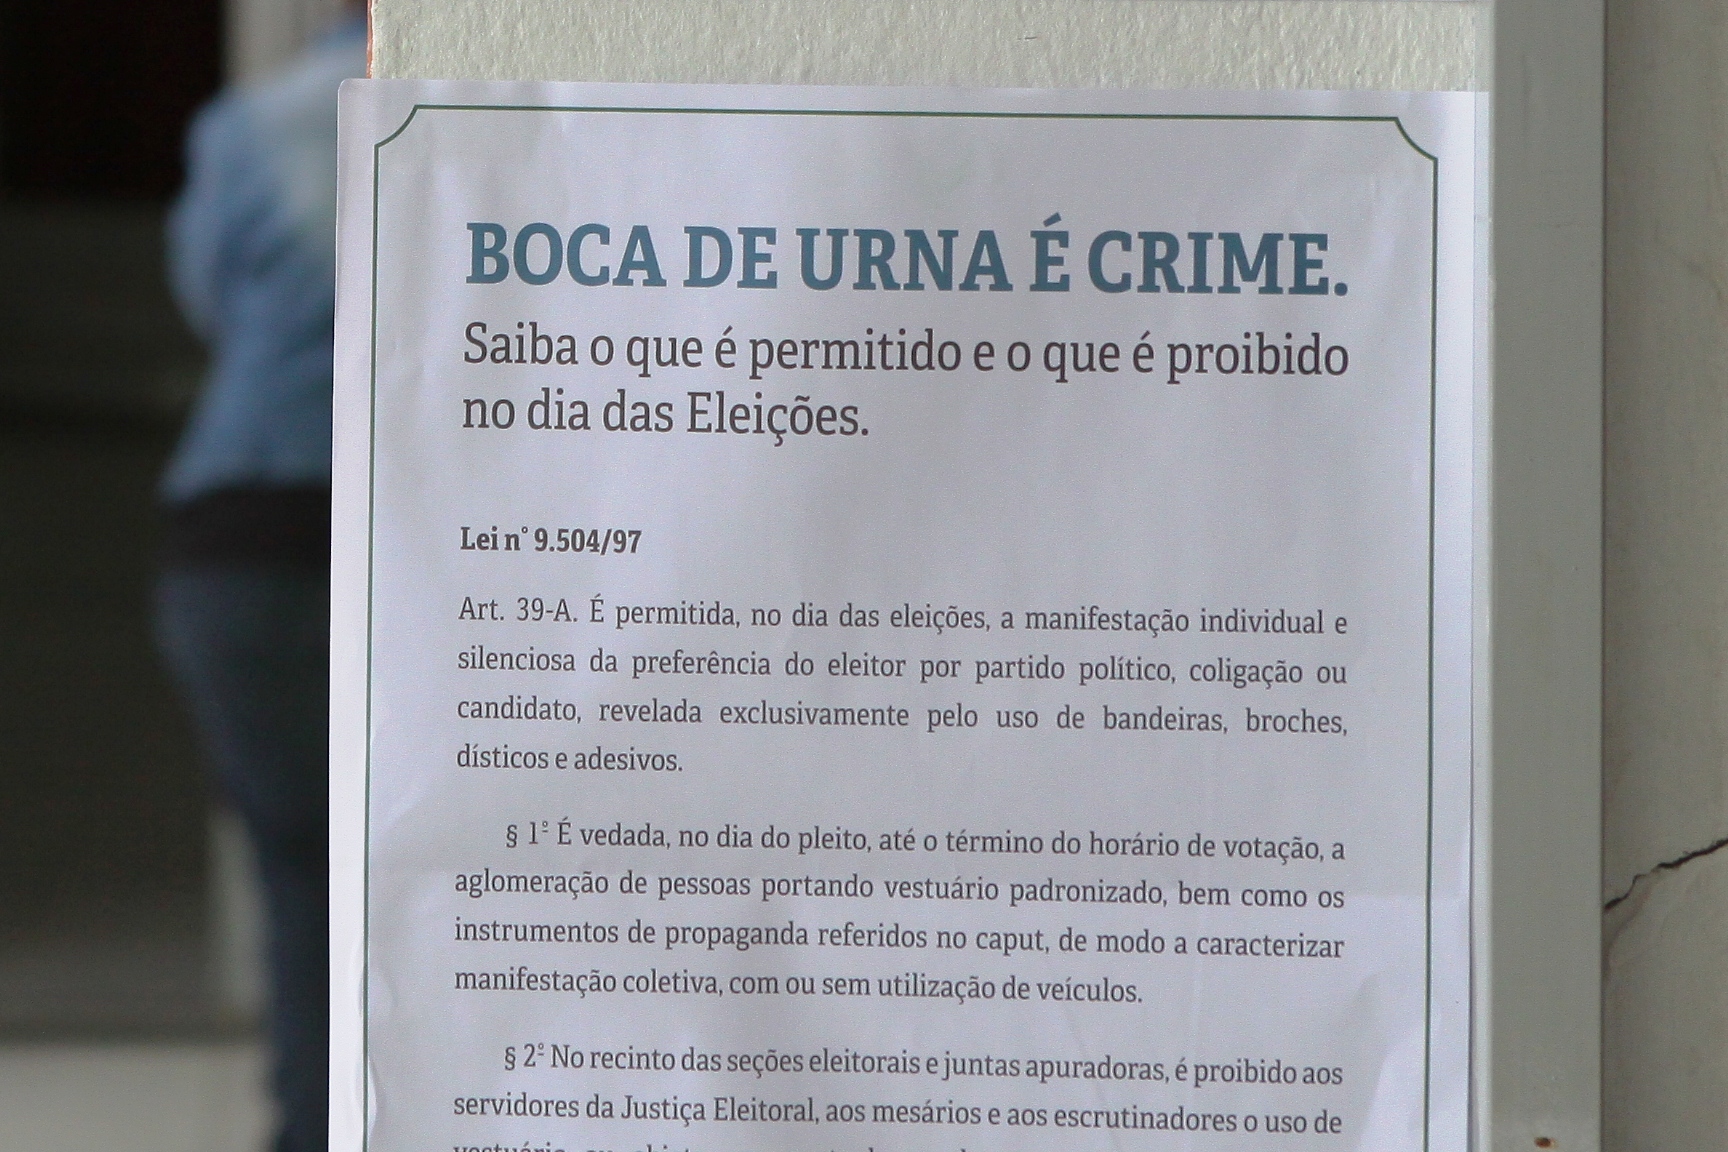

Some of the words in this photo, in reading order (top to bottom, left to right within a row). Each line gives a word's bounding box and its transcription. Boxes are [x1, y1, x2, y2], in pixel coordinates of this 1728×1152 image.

[465, 221, 668, 288] BOCA
[682, 225, 778, 290] DE
[795, 227, 1014, 292] URNA
[1029, 212, 1071, 293] É
[1087, 229, 1349, 297] CRIME.
[463, 321, 579, 366] Saiba
[590, 335, 615, 367] o
[626, 335, 703, 378] que
[714, 324, 737, 369] é
[748, 327, 962, 381] permitido
[973, 340, 995, 372] e
[1007, 341, 1032, 372] o
[1043, 341, 1121, 384] que
[1132, 329, 1155, 374] é
[1166, 331, 1349, 385] proibido
[462, 398, 516, 430] no
[527, 386, 592, 431] dia
[602, 388, 674, 433] das
[686, 390, 869, 448] Eleições.
[459, 525, 500, 551] Lei
[533, 527, 643, 556] 9.504/97
[457, 596, 505, 621] Art.
[516, 596, 578, 623] 39-A.
[589, 592, 605, 623] É
[615, 599, 741, 630] permitida,
[750, 608, 782, 627] no
[791, 601, 829, 627] dia
[839, 602, 880, 628] das
[890, 602, 991, 636] eleições,
[1000, 611, 1015, 630] a
[1024, 605, 1190, 639] manifestação
[1199, 607, 1325, 635] individual
[1334, 616, 1348, 635] e
[457, 644, 576, 672] silenciosa
[589, 647, 619, 673] da
[631, 648, 772, 680] preferência
[784, 650, 815, 677] do
[827, 651, 907, 677] eleitor
[919, 659, 962, 684] por
[975, 654, 1065, 685] partido
[1078, 655, 1176, 687] político,
[1189, 656, 1303, 690] coligação
[1316, 665, 1348, 685] ou
[457, 694, 582, 725] candidato,
[598, 697, 703, 724] revelada
[719, 699, 910, 727] exclusivamente
[926, 702, 978, 734] pelo
[996, 710, 1039, 729] uso
[1056, 703, 1085, 730] de
[1102, 704, 1228, 735] bandeiras,
[1245, 706, 1348, 737] broches,
[456, 742, 549, 770] dísticos
[554, 751, 568, 770] e
[573, 745, 683, 772] adesivos.
[505, 823, 518, 849] §
[556, 815, 572, 846] É
[579, 821, 671, 851] vedada,
[678, 829, 709, 848] no
[716, 823, 754, 849] dia
[760, 824, 791, 849] do
[797, 825, 872, 856] pleito,
[879, 827, 916, 852] até
[923, 834, 938, 852] o
[945, 828, 1044, 854] término
[1051, 829, 1082, 855] do
[1088, 830, 1180, 857] horário
[1187, 832, 1216, 858] de
[1222, 836, 1325, 866] votação,
[1331, 842, 1346, 861] a
[454, 867, 609, 901] aglomeração
[619, 868, 648, 895] de
[657, 876, 751, 901] pessoas
[761, 872, 874, 903] portando
[883, 875, 999, 901] vestuário
[1009, 877, 1168, 908] padronizado,
[1177, 879, 1231, 906] bem
[1240, 888, 1308, 908] como
[1317, 889, 1345, 909] os
[454, 915, 619, 944] instrumentos
[627, 918, 656, 944] de
[665, 920, 809, 952] propaganda
[818, 921, 928, 949] referidos
[936, 930, 967, 950] no
[975, 929, 1050, 957] caput,
[1058, 926, 1088, 953] de
[1096, 928, 1166, 954] modo
[1173, 936, 1188, 955] a
[1196, 932, 1345, 959] caracterizar
[454, 965, 617, 999] manifestação
[622, 967, 724, 998] coletiva,
[729, 976, 780, 995] com
[785, 976, 816, 995] ou
[822, 977, 871, 996] sem
[877, 971, 996, 1006] utilização
[1001, 974, 1031, 1001] de
[1036, 976, 1143, 1004] veículos.
[504, 1045, 517, 1072] §
[550, 1043, 585, 1069] No
[589, 1045, 676, 1071] recinto
[681, 1046, 722, 1072] das
[726, 1048, 804, 1080] seções
[808, 1047, 921, 1075] eleitorais
[925, 1056, 939, 1075] e
[941, 1050, 1021, 1082] juntas
[1025, 1054, 1170, 1085] apuradoras,
[1174, 1056, 1189, 1082] é
[1193, 1057, 1298, 1089] proibido
[1301, 1066, 1344, 1086] aos
[453, 1091, 580, 1118] servidores
[585, 1092, 615, 1119] da
[620, 1094, 707, 1128] Justiça
[713, 1096, 820, 1125] Eleitoral,
[825, 1103, 866, 1123] aos
[871, 1098, 982, 1125] mesários
[987, 1107, 1001, 1126] e
[1006, 1107, 1048, 1127] aos
[1053, 1104, 1238, 1133] escrutinadores
[1243, 1114, 1259, 1133] o
[1264, 1114, 1308, 1134] uso
[1313, 1108, 1343, 1135] de
